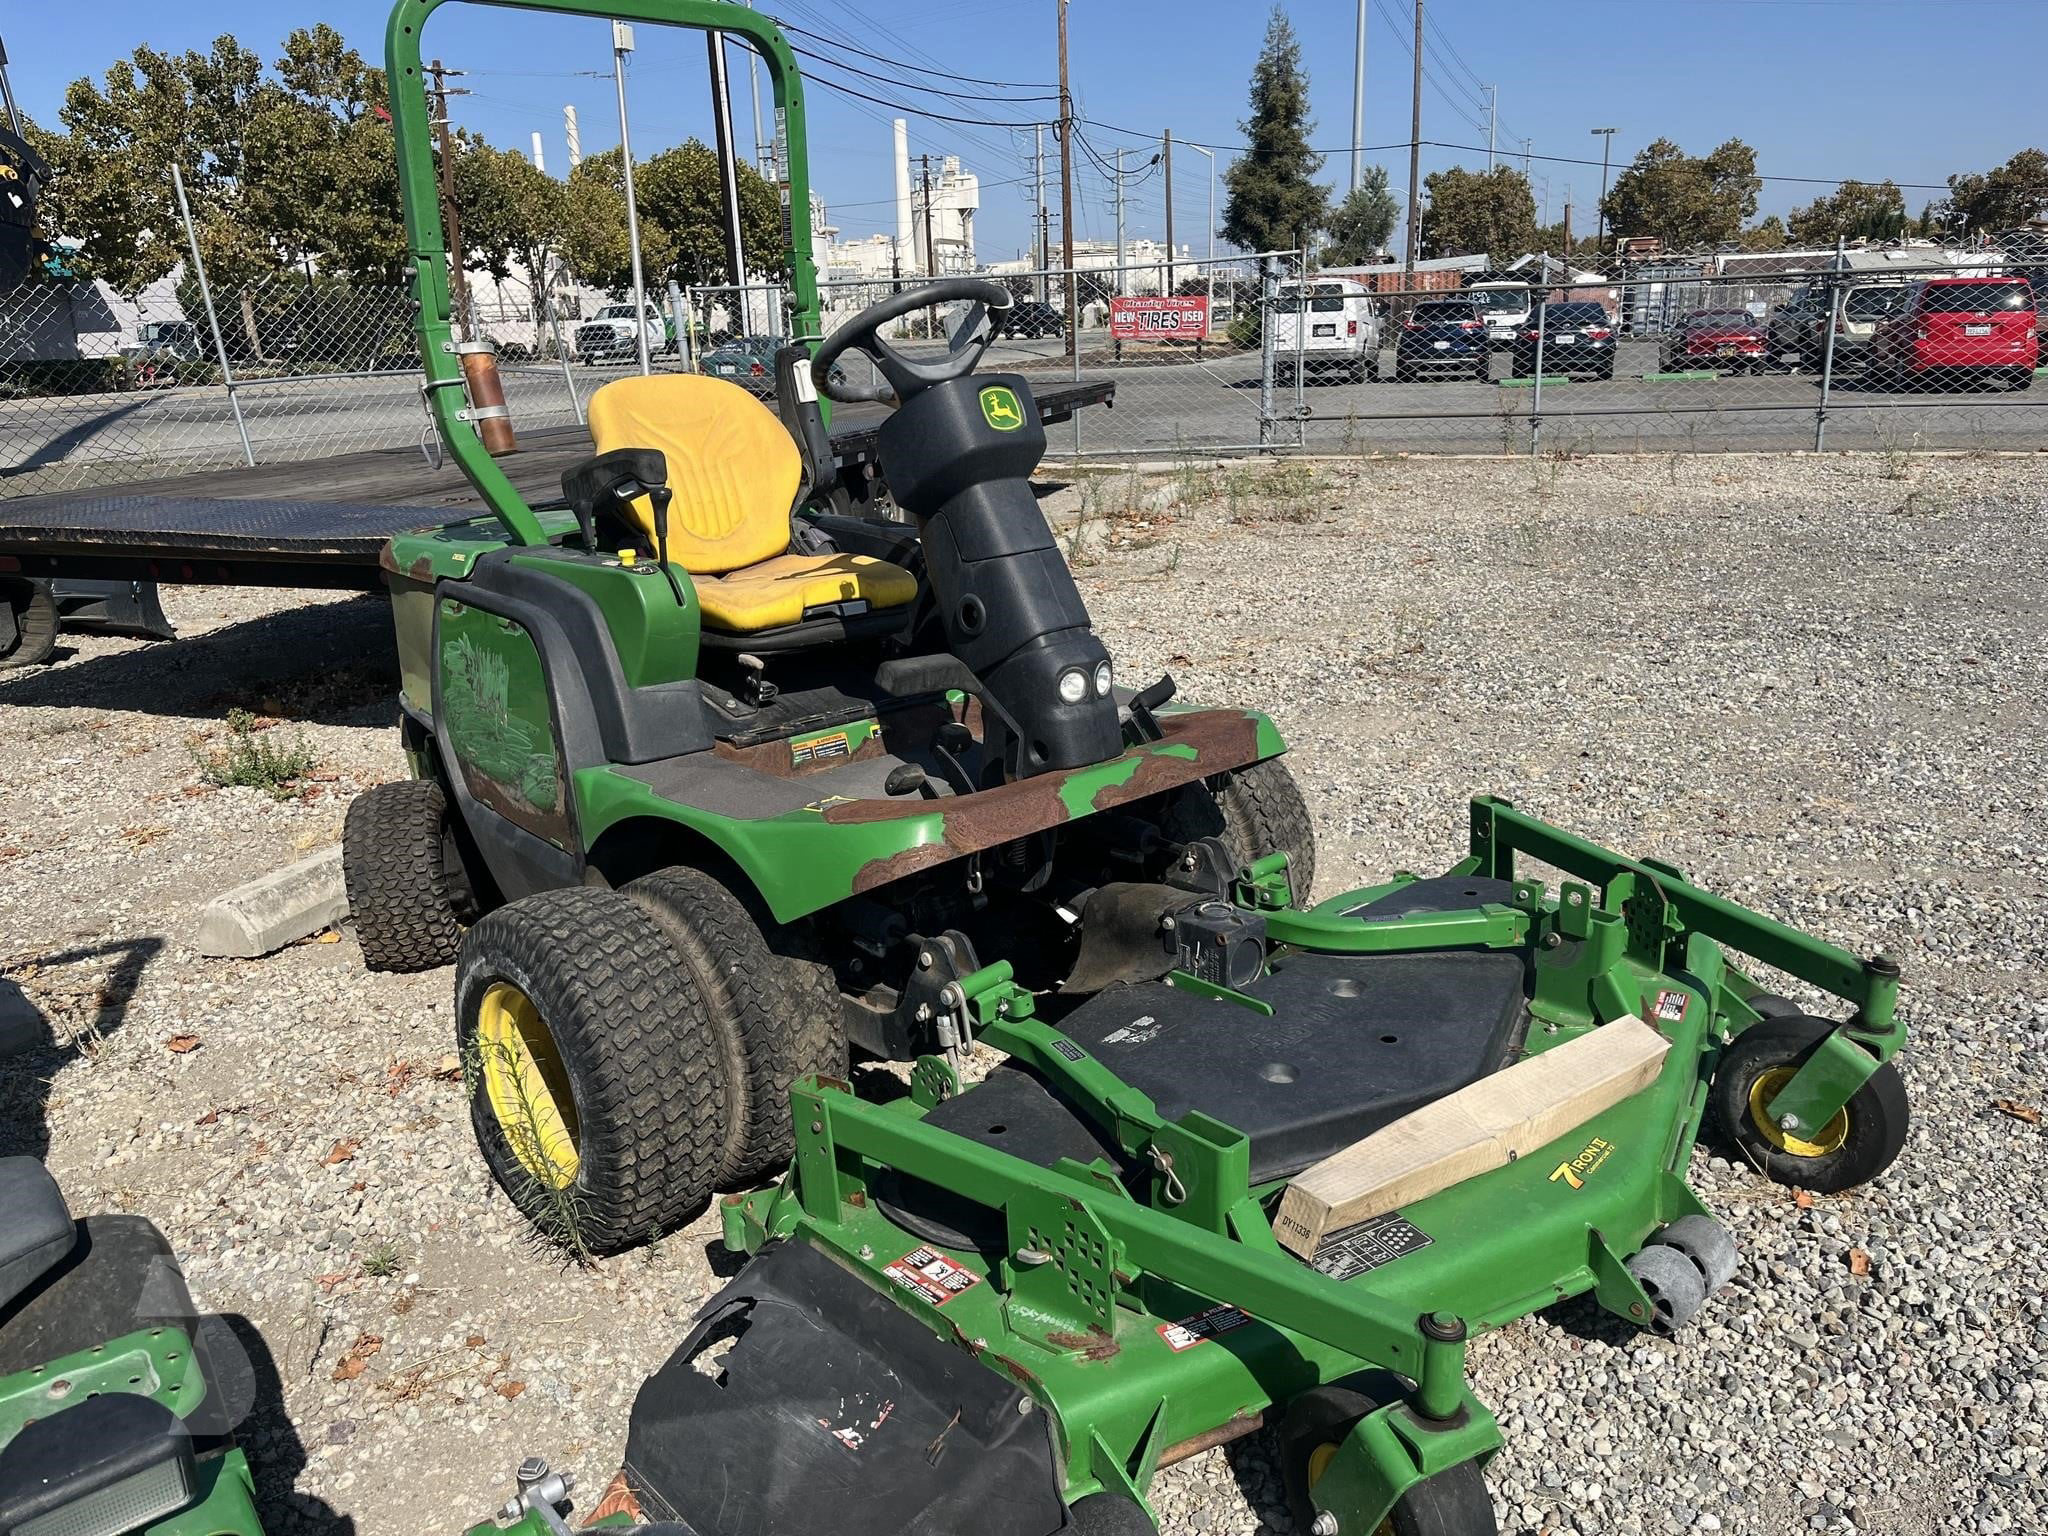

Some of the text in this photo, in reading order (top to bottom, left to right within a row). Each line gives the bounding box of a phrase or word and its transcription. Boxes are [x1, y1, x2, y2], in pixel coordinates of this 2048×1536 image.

[1115, 310, 1203, 331] NEW TIRES USED
[1282, 1215, 1310, 1240] DY11336
